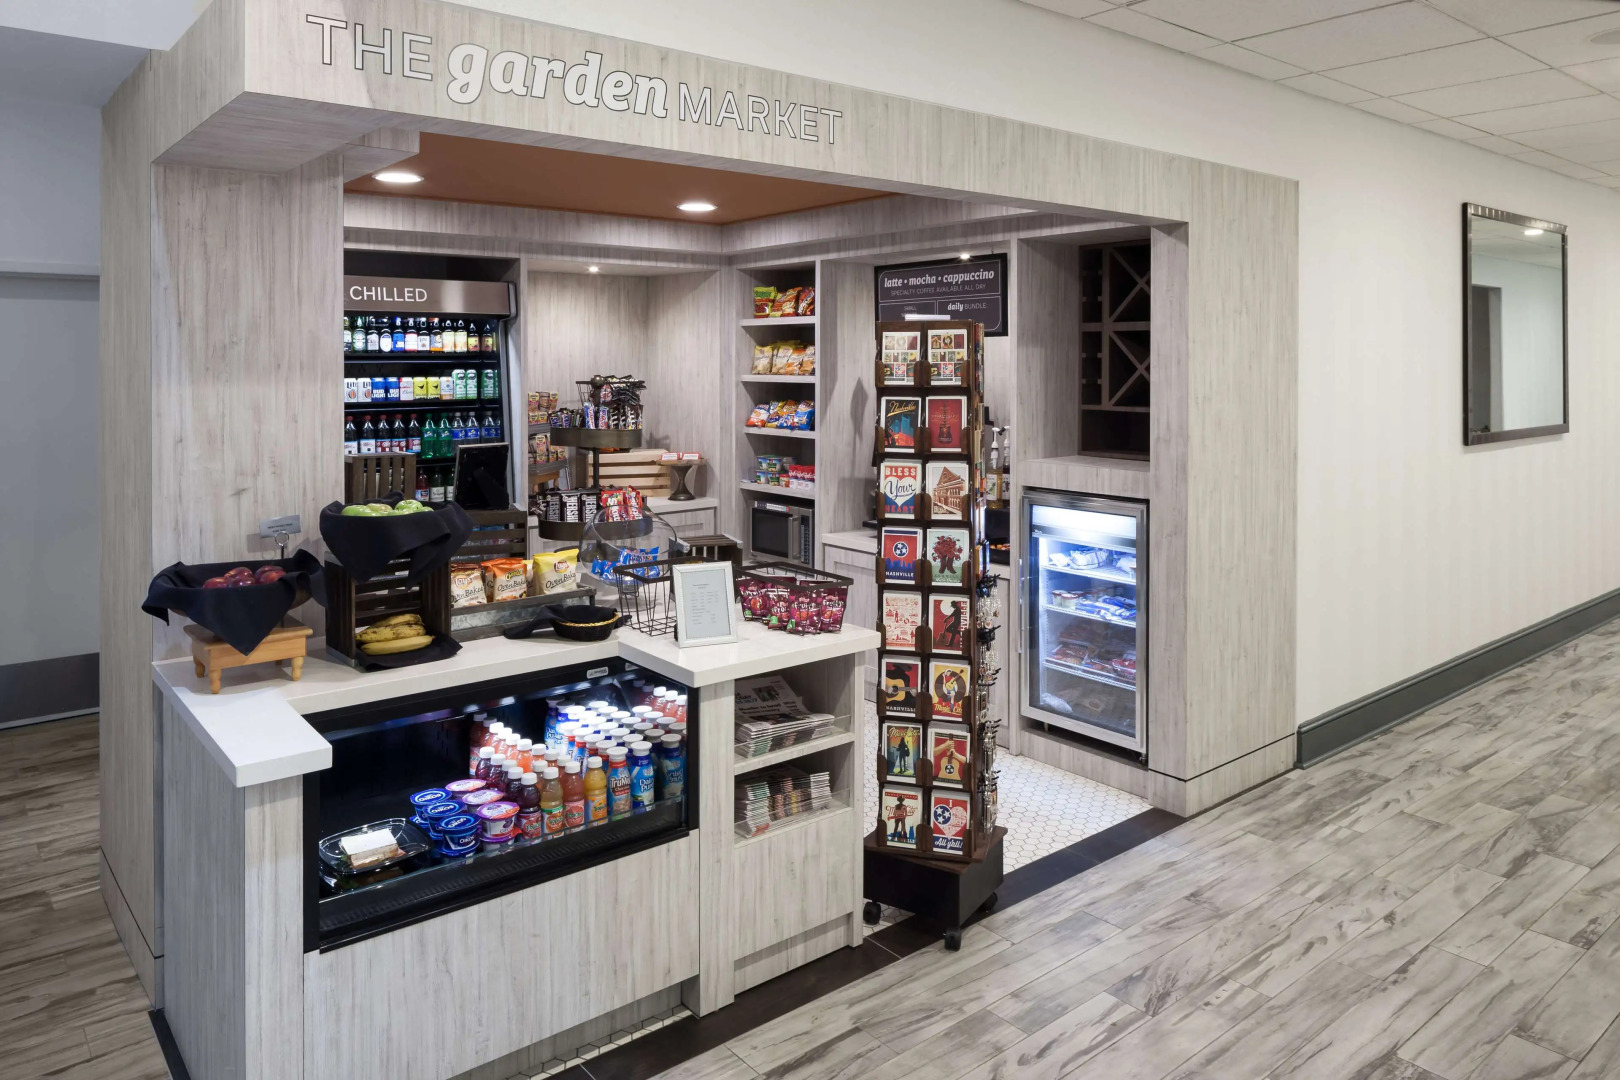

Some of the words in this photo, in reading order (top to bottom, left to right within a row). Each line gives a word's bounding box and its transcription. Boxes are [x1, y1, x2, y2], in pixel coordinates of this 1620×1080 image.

[306, 14, 434, 81] THE
[446, 43, 668, 118] garden
[678, 82, 843, 144] MARKET
[884, 276, 902, 288] latte
[908, 274, 936, 286] mocha
[943, 268, 994, 285] cappuccino
[350, 286, 428, 302] CHILLED
[936, 285, 963, 293] AVAILABLE
[947, 302, 964, 312] daily
[885, 467, 916, 476] BLESS
[884, 479, 916, 500] Your
